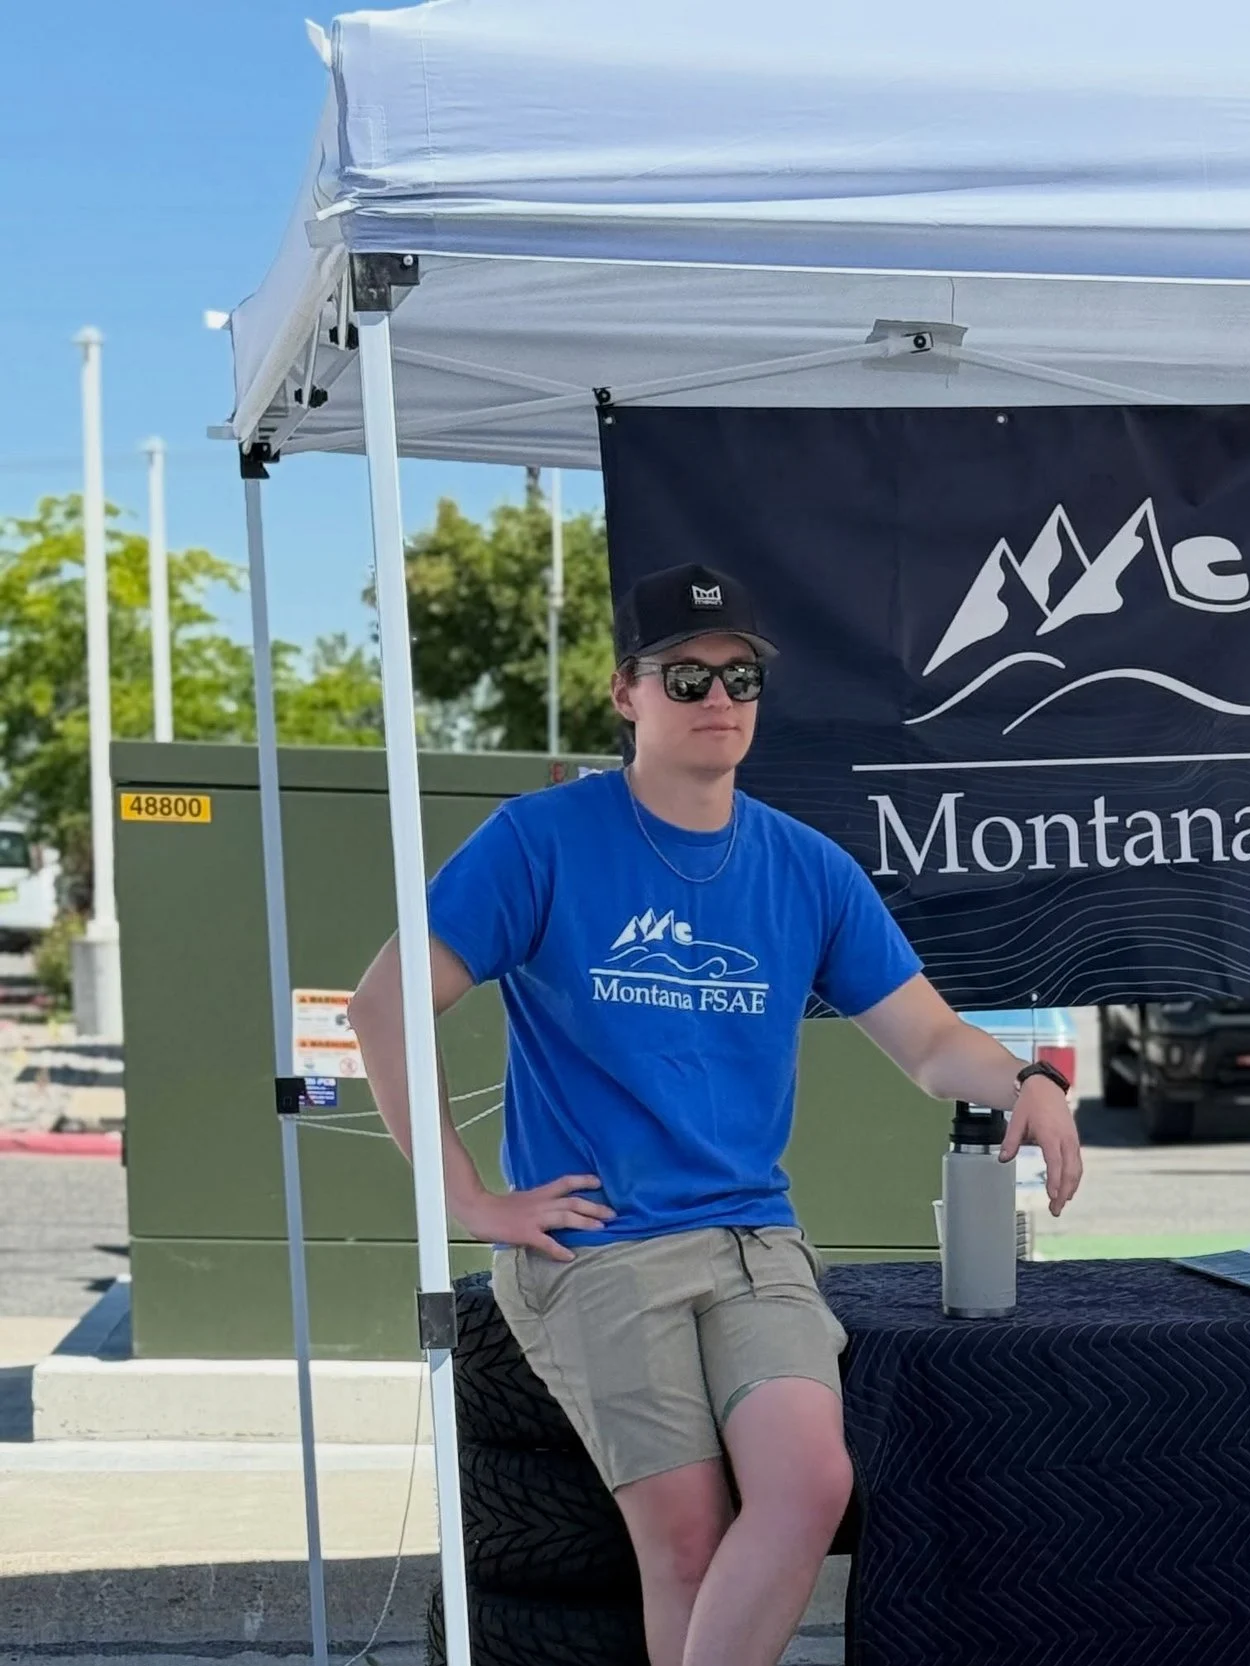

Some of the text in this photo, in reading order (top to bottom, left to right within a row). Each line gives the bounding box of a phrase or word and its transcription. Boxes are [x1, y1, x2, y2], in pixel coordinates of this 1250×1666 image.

[130, 796, 202, 817] 48800
[592, 976, 766, 1014] Montana FSAE
